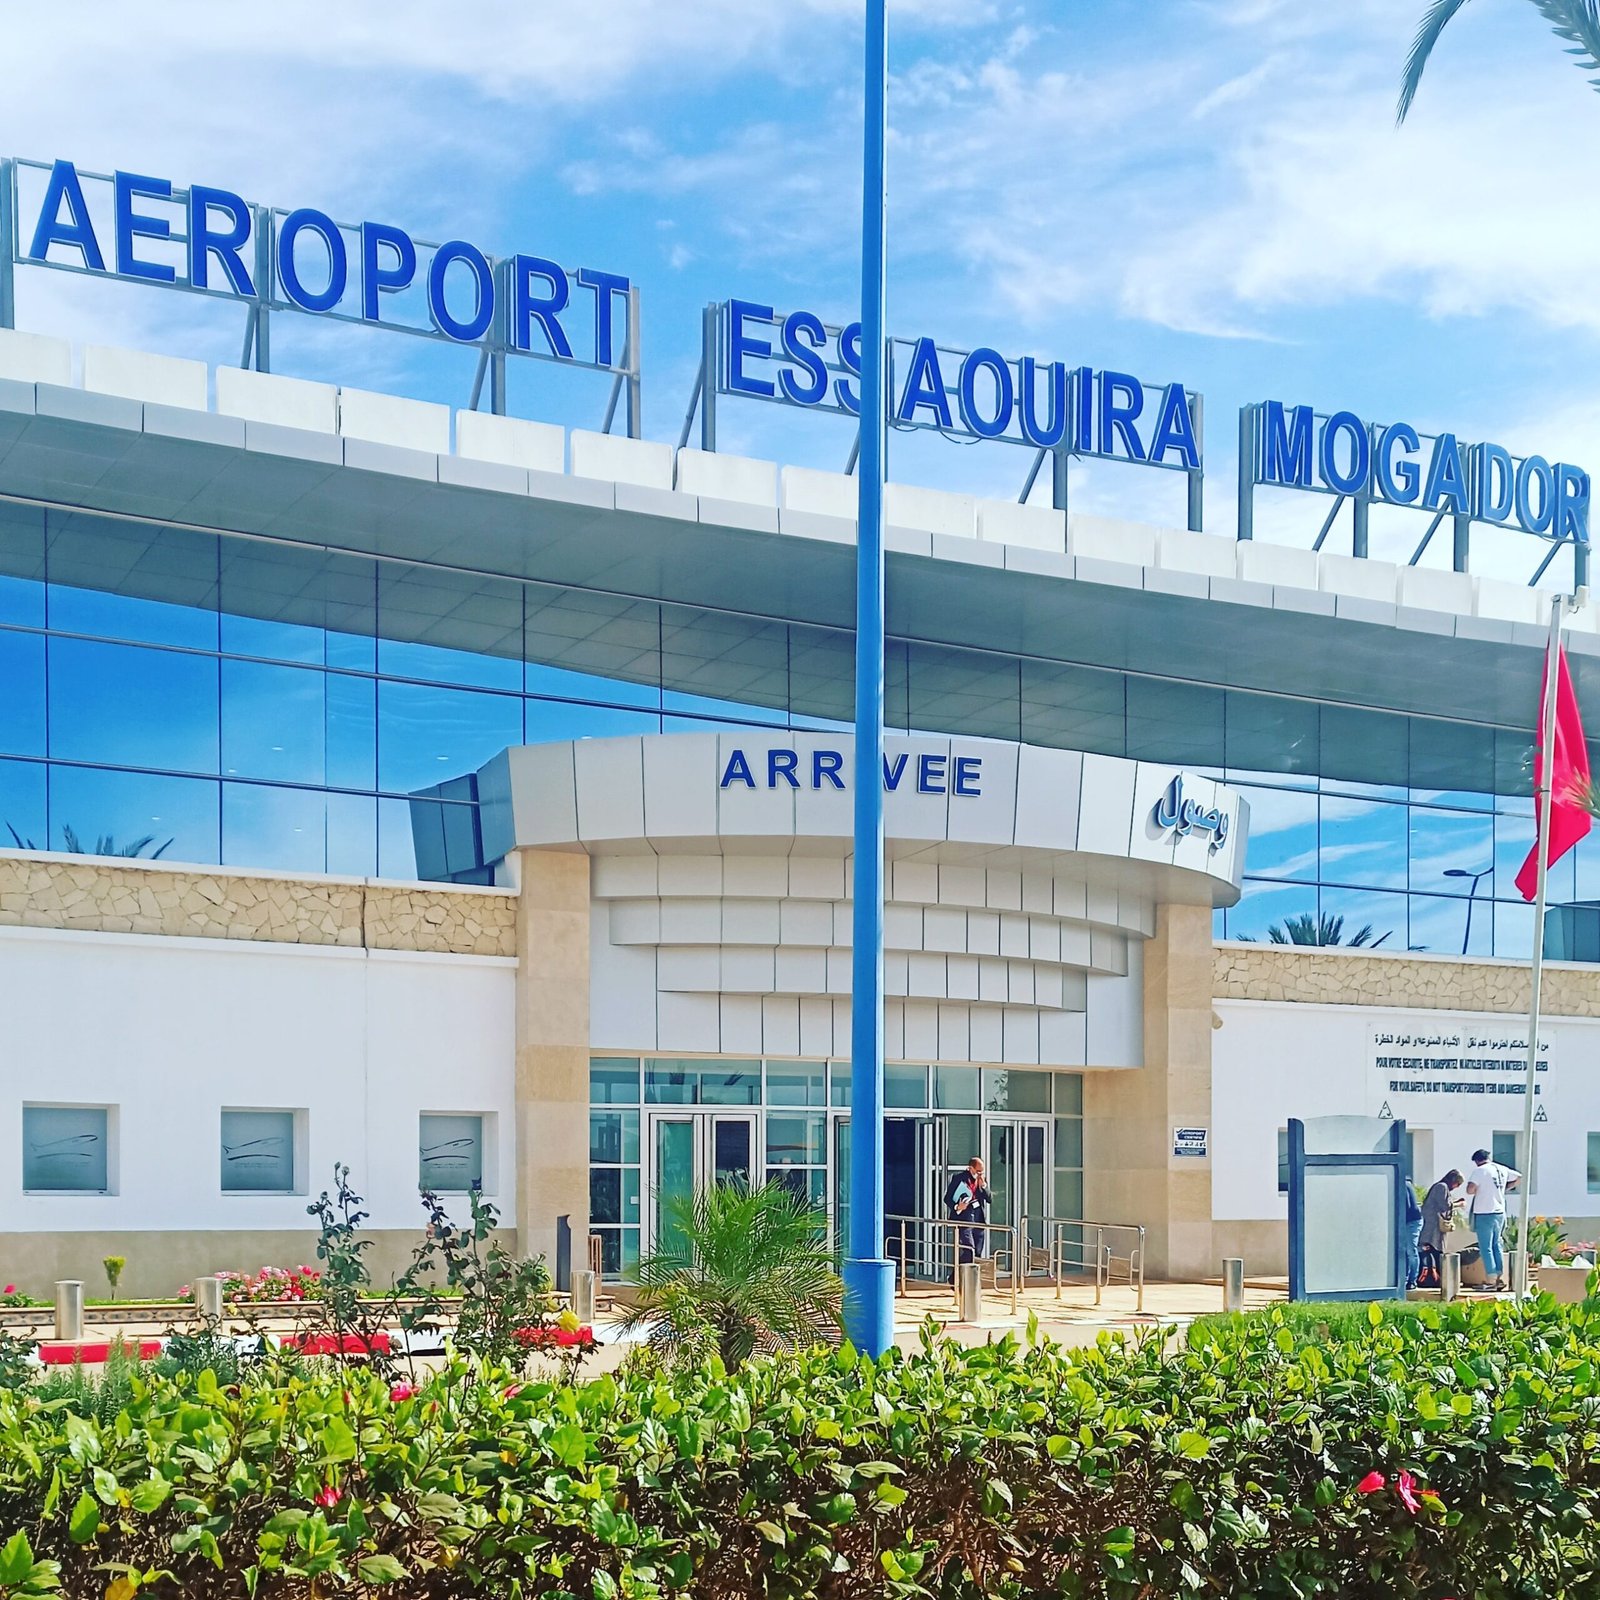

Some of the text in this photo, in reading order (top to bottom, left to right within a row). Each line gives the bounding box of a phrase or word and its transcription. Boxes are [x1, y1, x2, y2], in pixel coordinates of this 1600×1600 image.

[28, 159, 630, 367] AEROPORT
[1262, 400, 1591, 543] MOGADOR
[720, 749, 983, 796] ARRVEE
[1155, 774, 1229, 849] وصول
